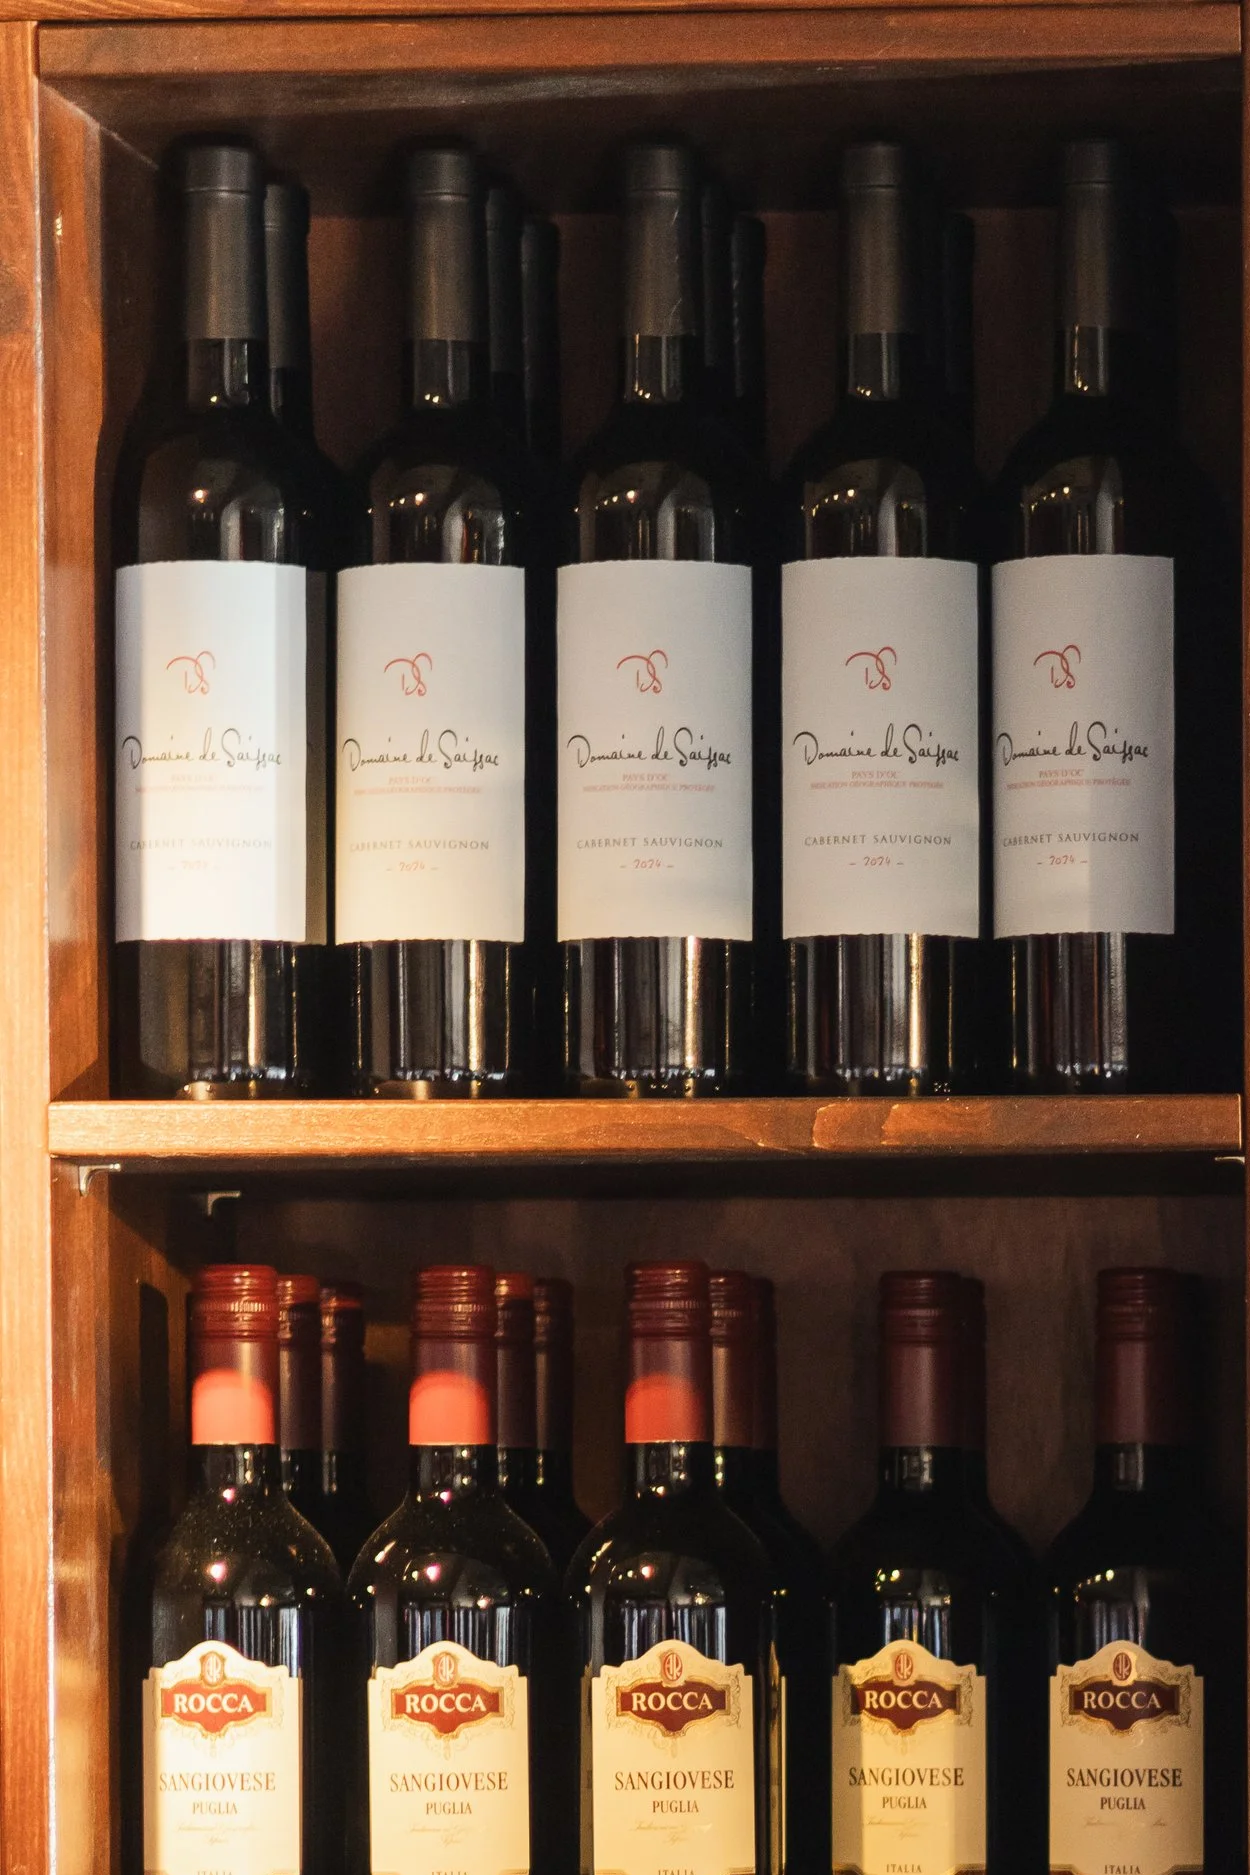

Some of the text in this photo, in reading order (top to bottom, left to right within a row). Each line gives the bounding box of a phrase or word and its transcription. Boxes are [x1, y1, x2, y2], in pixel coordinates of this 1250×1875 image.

[122, 735, 192, 770] Domaine
[199, 727, 220, 762] de
[342, 736, 411, 772] Domaine
[416, 729, 437, 764] de
[567, 735, 647, 768] Domaine
[651, 726, 673, 760] de
[793, 731, 877, 765] Domaine
[880, 723, 902, 758] de
[997, 732, 1062, 767] Domaine
[1065, 721, 1087, 756] de
[408, 840, 489, 850] SAUVIGNON
[577, 837, 723, 849] CABERNET SAUVIGNON
[804, 834, 952, 846] CABERNET SAUVIGNON
[1003, 833, 1139, 847] CABERNET SAUVIGNON
[174, 1693, 253, 1713] ROCCA
[405, 1693, 486, 1713] ROCCA
[631, 1691, 713, 1711] ROCCA
[864, 1690, 942, 1709] ROCCA
[1083, 1691, 1161, 1710] ROCCA
[159, 1772, 276, 1792] SANGIOVESE
[390, 1771, 508, 1792] SANGIOVESE
[615, 1770, 735, 1791] SANGIOVESE
[848, 1766, 964, 1787] SANGIOVESE
[1067, 1768, 1183, 1787] SANGIOVESE
[192, 1801, 239, 1815] PUGLIA
[425, 1801, 472, 1816] PUGLIA
[652, 1800, 699, 1814] PUGLIA
[881, 1796, 927, 1809] PUGLIA
[1100, 1796, 1146, 1810] PUGLIA
[886, 1864, 922, 1873] ITALIA
[1104, 1864, 1141, 1874] ITALIA
